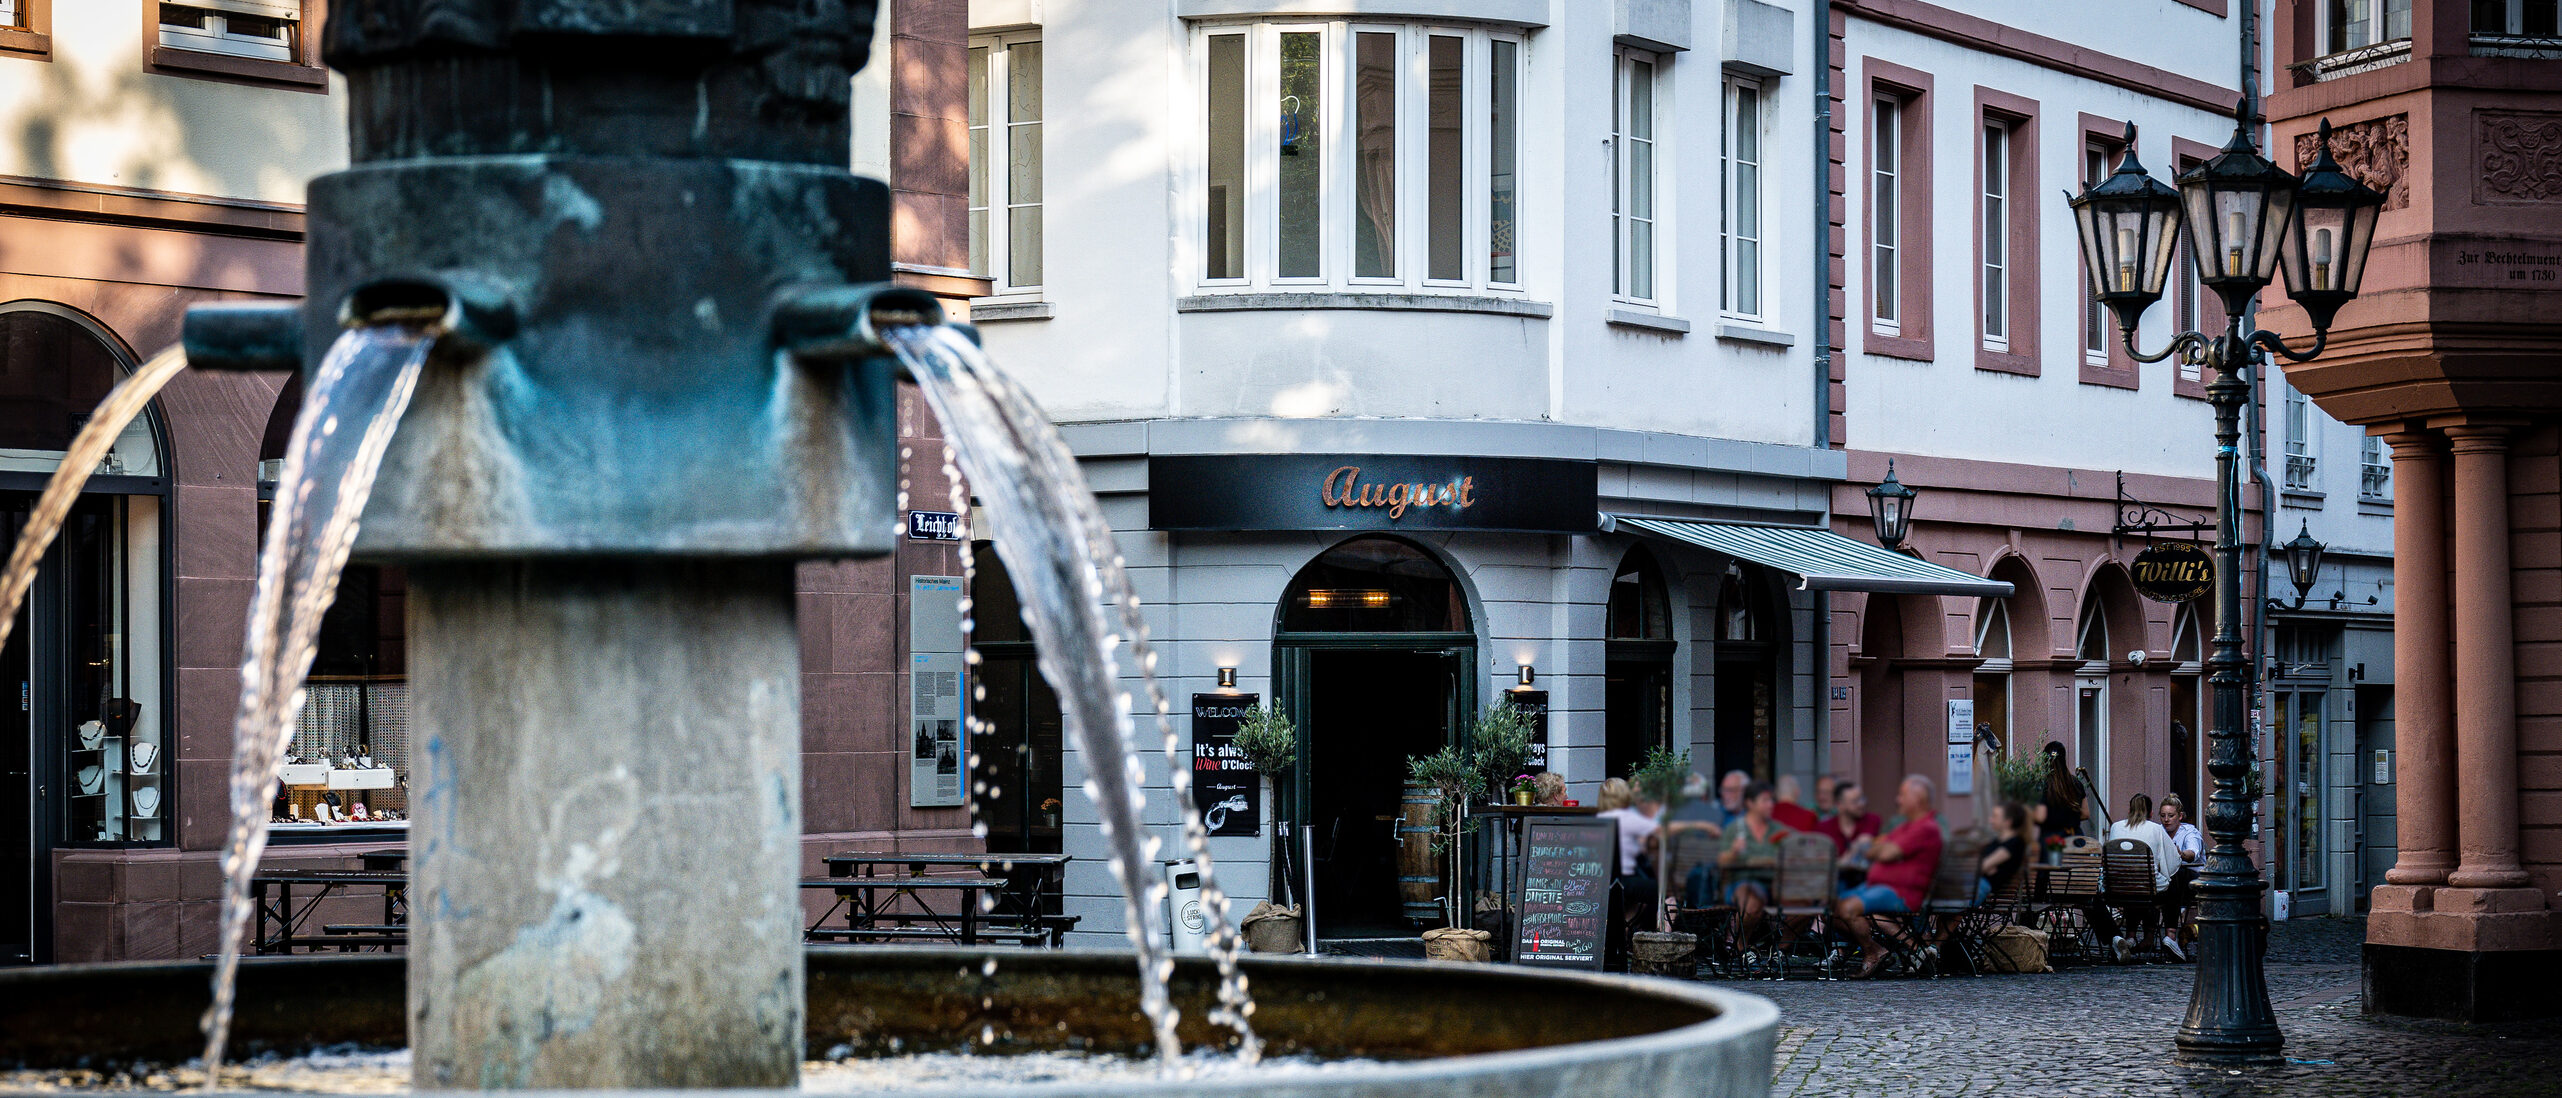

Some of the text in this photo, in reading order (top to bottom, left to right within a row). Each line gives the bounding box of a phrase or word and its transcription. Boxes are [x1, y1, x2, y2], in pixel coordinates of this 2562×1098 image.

[2457, 250, 2562, 266] Zur Bechtelmuent
[2509, 269, 2526, 280] um
[1321, 465, 1475, 519] August
[2135, 560, 2212, 582] Willi's
[1196, 743, 1249, 759] It's alwa
[1195, 757, 1221, 771] Wine
[1216, 783, 1236, 791] August
